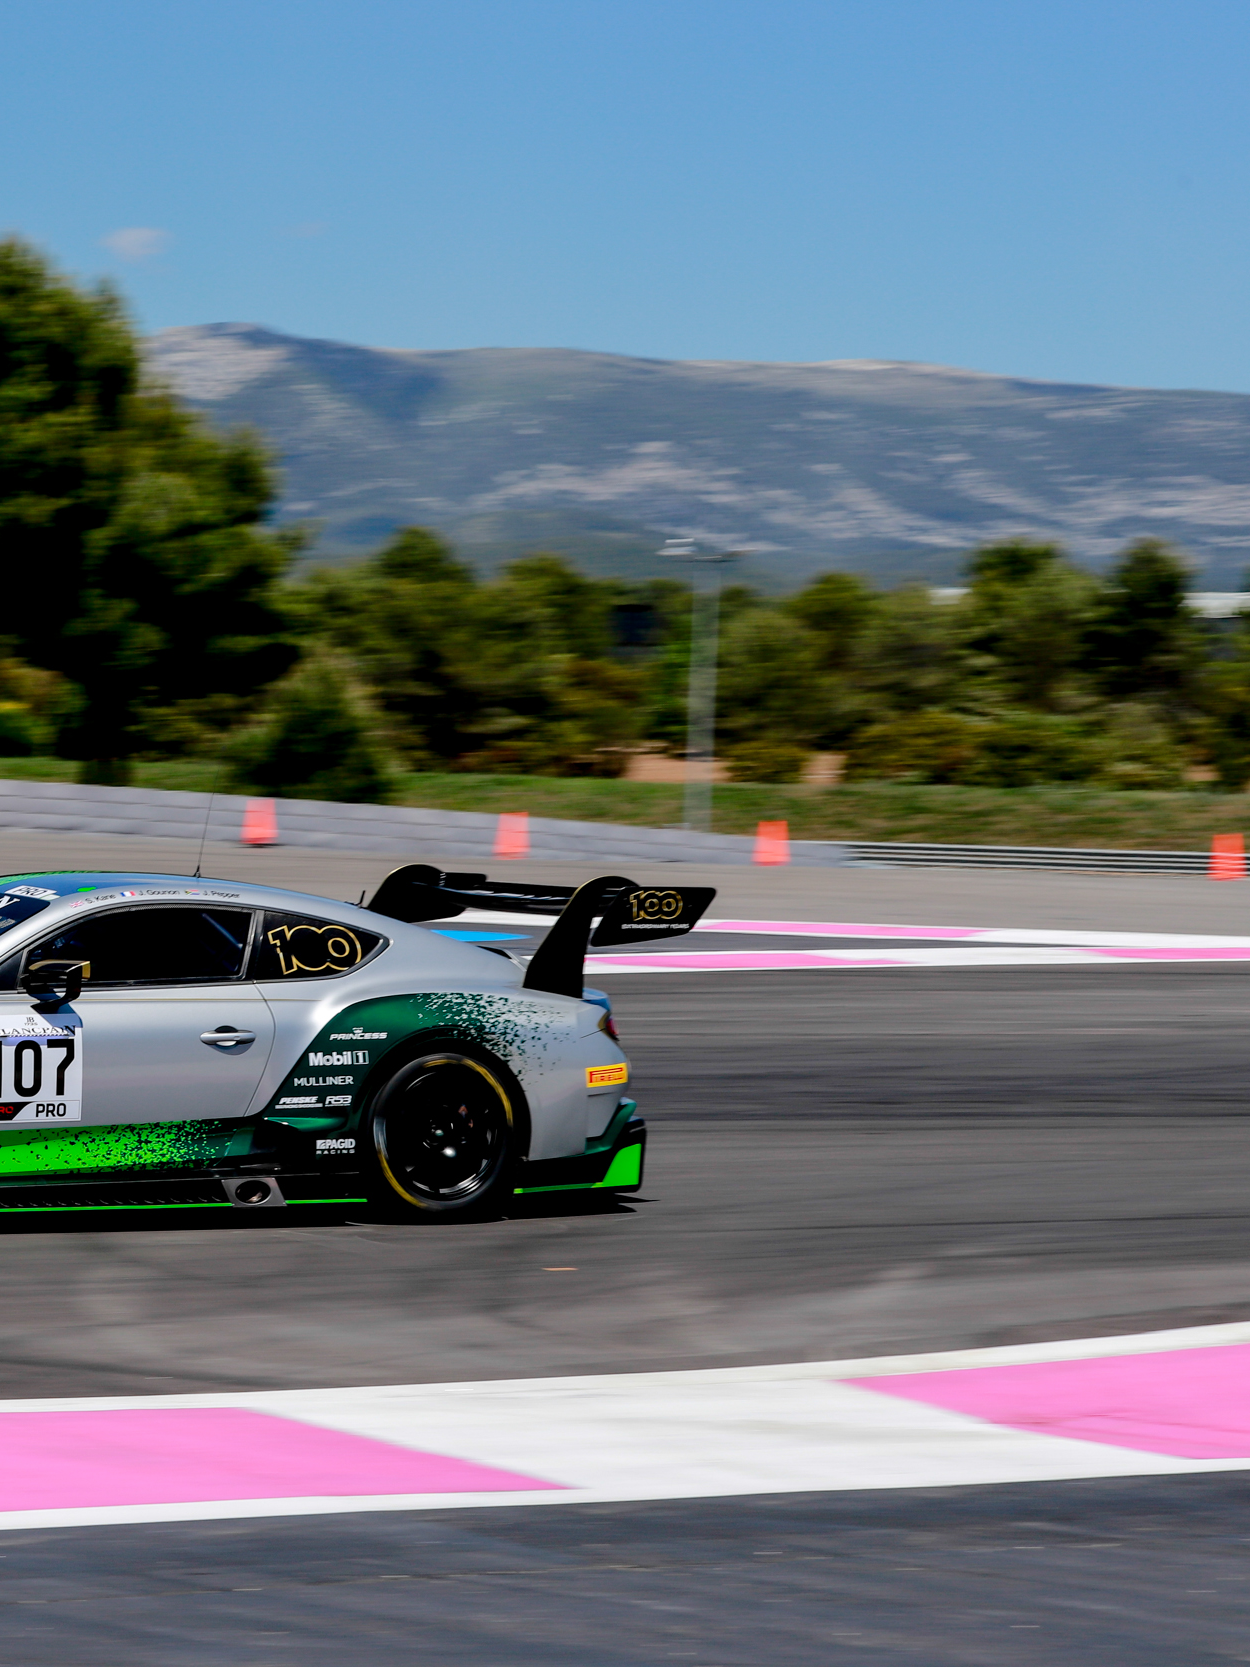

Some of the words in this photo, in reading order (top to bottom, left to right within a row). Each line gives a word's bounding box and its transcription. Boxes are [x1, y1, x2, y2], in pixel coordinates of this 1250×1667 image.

[629, 890, 684, 921] 100
[267, 925, 362, 975] 100
[329, 1031, 388, 1041] PRINCESS
[308, 1051, 352, 1067] Mobil
[293, 1075, 354, 1087] MULLINER
[279, 1095, 319, 1105] PENSKE
[35, 1102, 67, 1118] PRO
[326, 1138, 356, 1149] PAGID
